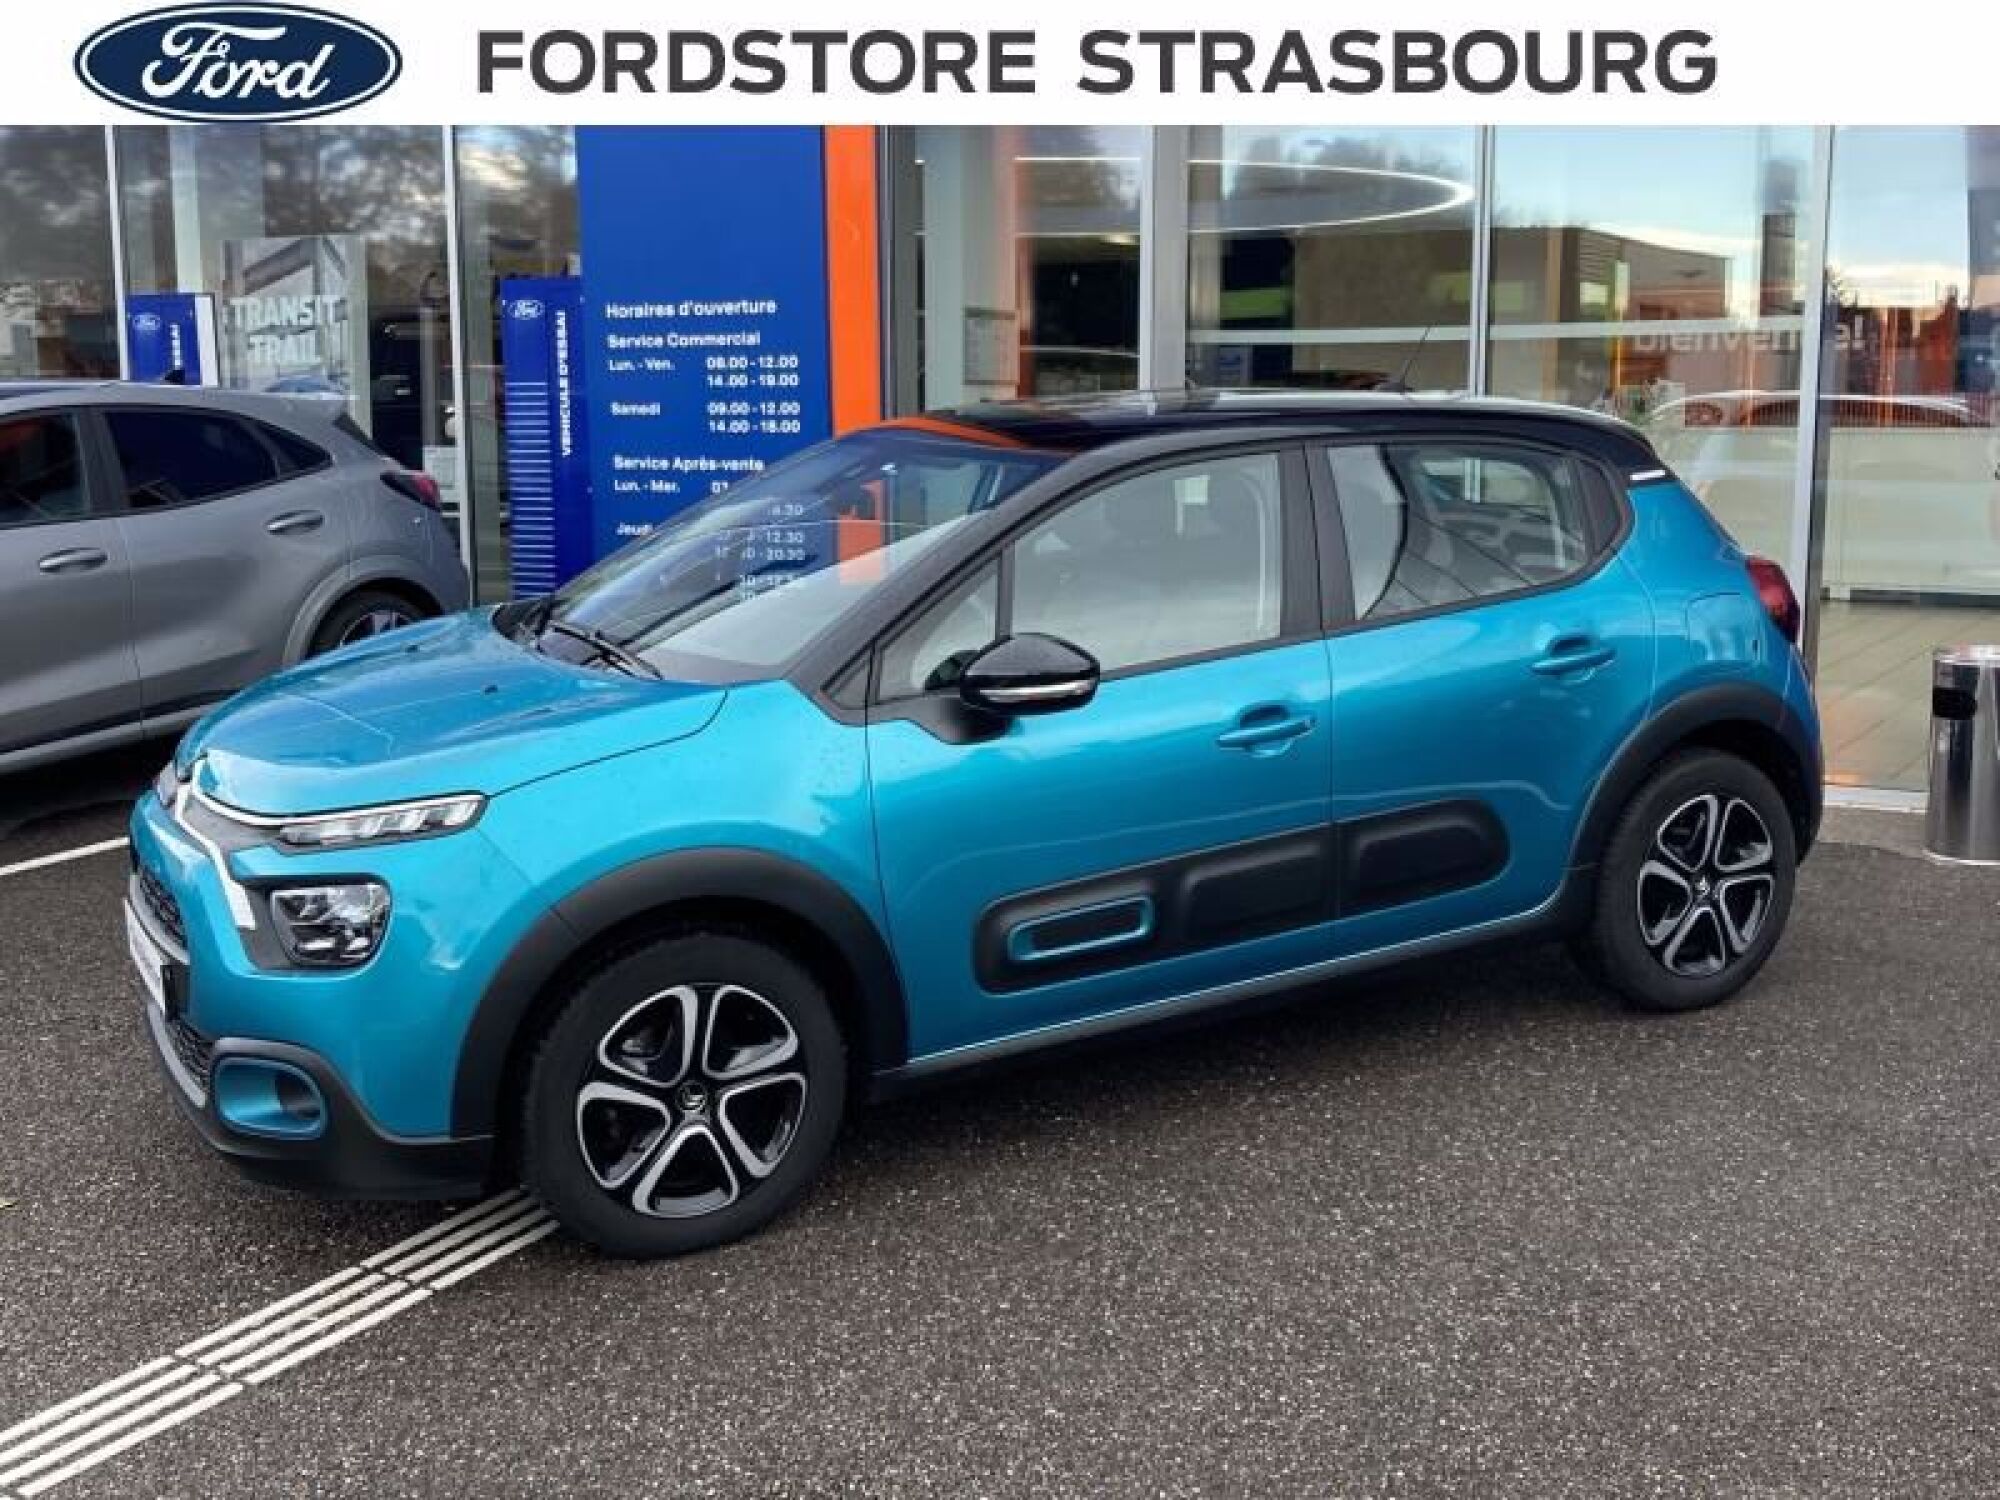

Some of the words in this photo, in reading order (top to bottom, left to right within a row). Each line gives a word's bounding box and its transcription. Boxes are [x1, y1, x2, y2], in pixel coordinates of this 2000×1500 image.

[229, 295, 342, 328] TRANSIT
[606, 302, 675, 318] Horaires
[679, 300, 777, 316] d'ouverture
[608, 334, 663, 348] Service
[667, 330, 761, 347] Commercial
[609, 359, 636, 371] Lun.
[645, 358, 676, 371] Ven.
[610, 402, 661, 415] Samedi
[613, 455, 669, 470] Service
[673, 455, 765, 472] Après-vente
[614, 479, 641, 491] Lun.
